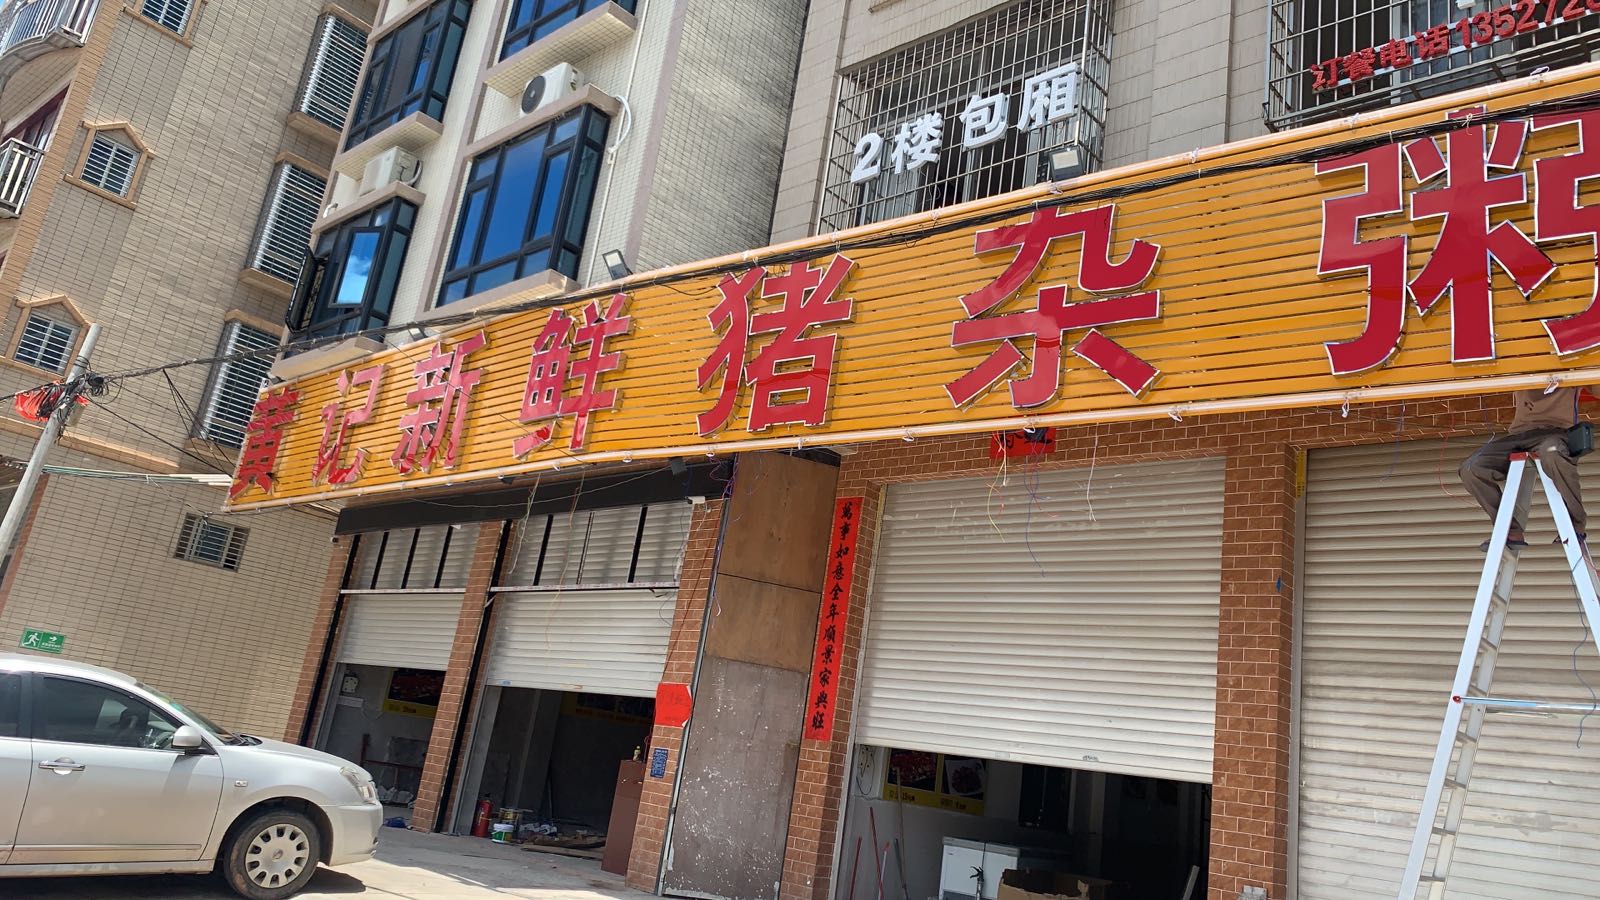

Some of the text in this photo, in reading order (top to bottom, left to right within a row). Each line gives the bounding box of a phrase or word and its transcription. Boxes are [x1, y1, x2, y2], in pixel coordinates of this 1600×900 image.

[1311, 0, 1600, 91] 订餐电话135272
[851, 62, 1081, 185] 2楼包厢
[229, 104, 1600, 500] 黄记新鲜猪杂粥
